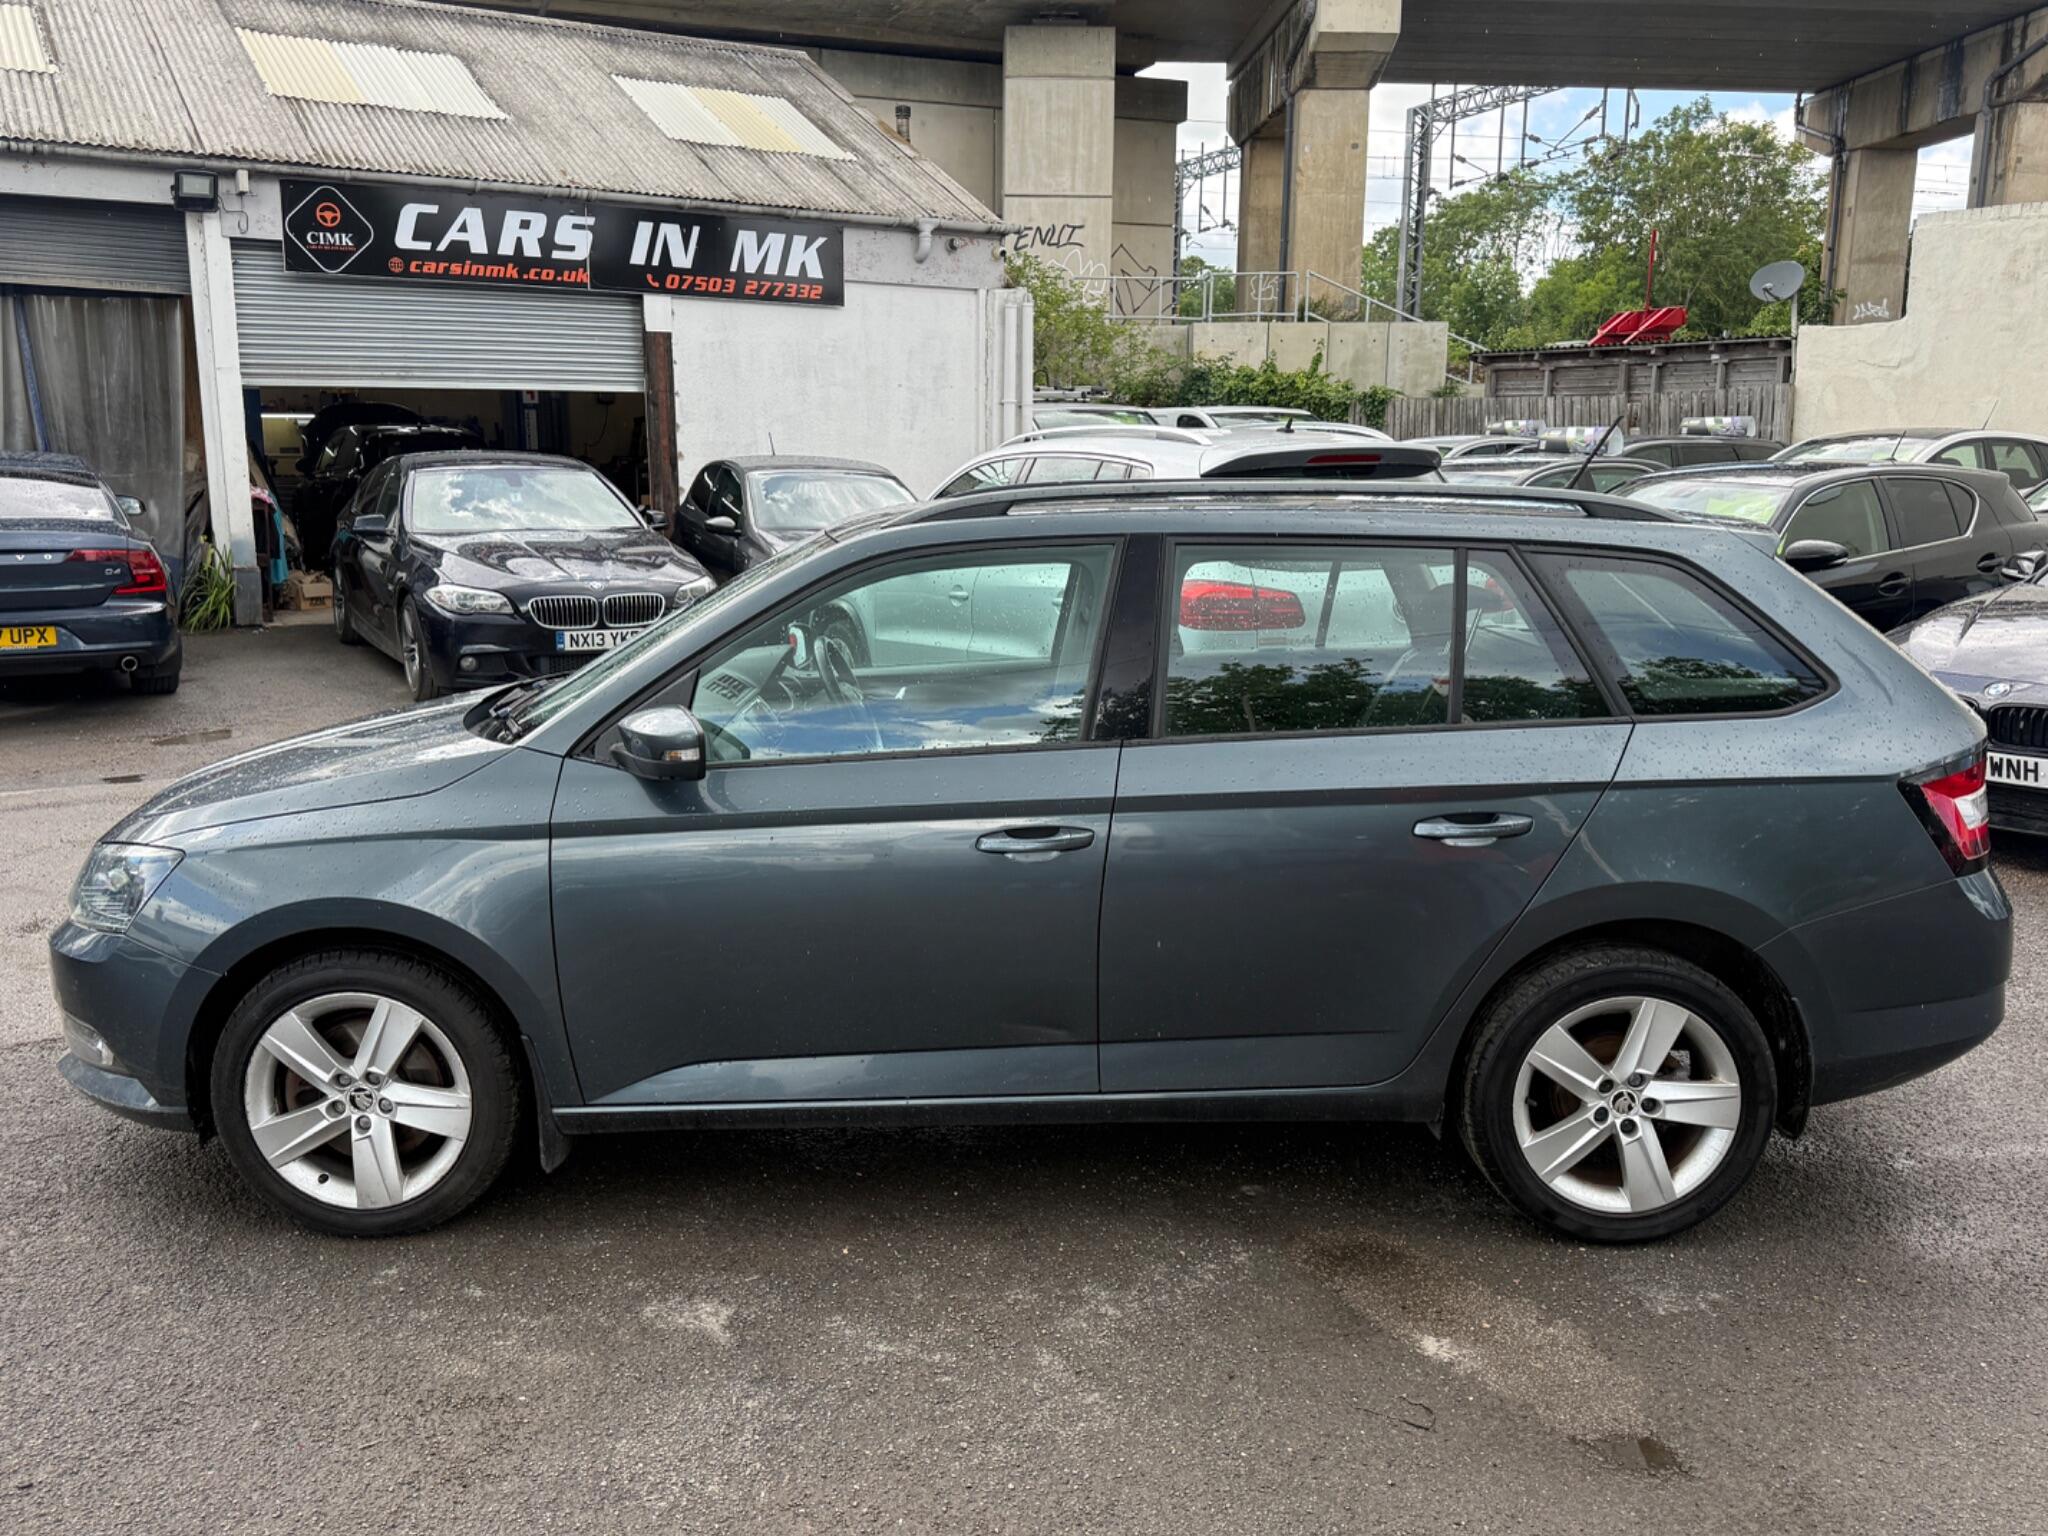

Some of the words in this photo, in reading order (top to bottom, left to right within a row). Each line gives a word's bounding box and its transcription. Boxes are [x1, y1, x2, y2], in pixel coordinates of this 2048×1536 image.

[306, 231, 355, 246] CIMK
[394, 203, 596, 261] CARS
[629, 221, 701, 269] IN
[729, 229, 828, 279] MK
[409, 258, 591, 284] carsinmk.co.uk
[665, 274, 736, 294] 07503
[744, 279, 824, 300] 277332
[10, 628, 48, 645] UPX
[569, 633, 606, 648] NX13
[1989, 755, 2039, 783] WNH
